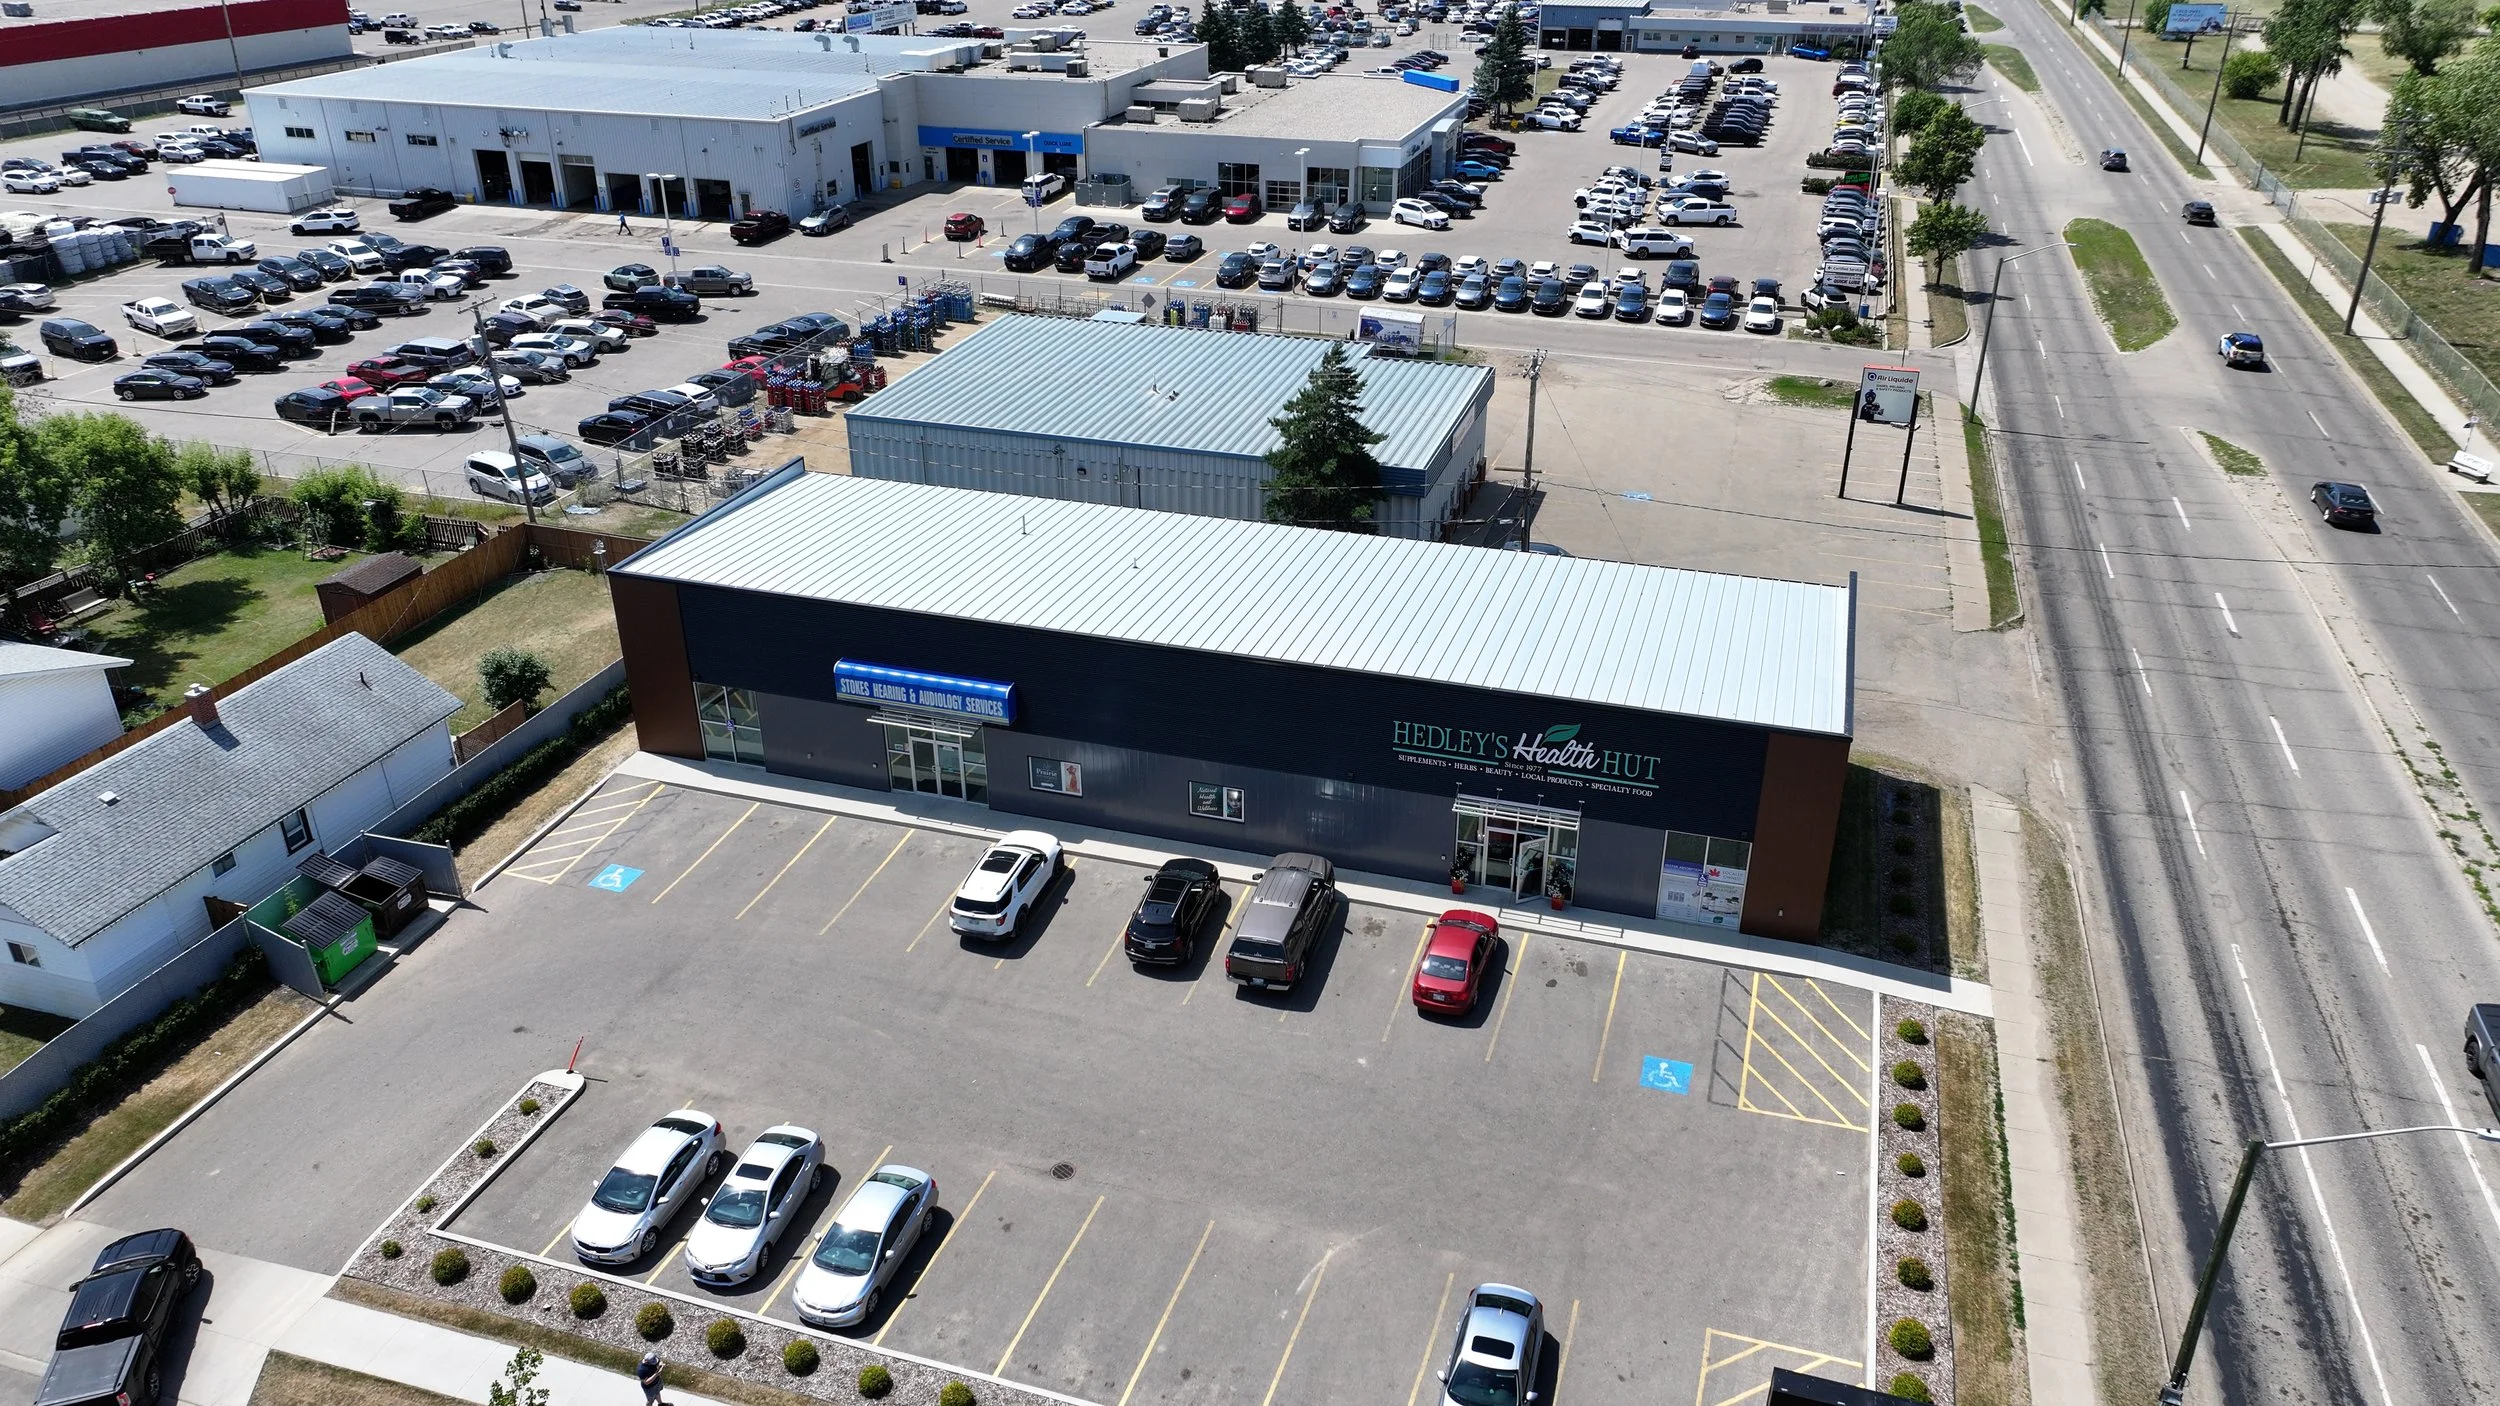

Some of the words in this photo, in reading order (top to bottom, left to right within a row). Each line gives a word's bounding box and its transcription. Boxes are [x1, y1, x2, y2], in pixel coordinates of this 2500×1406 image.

[874, 9, 895, 18] CERTIFIED
[953, 135, 983, 145] Certified
[985, 136, 1011, 146] Service
[1888, 376, 1914, 384] Liquide
[840, 678, 869, 697] STOKES
[873, 682, 907, 702] HEARING
[909, 689, 916, 703] &
[919, 690, 963, 711] AUDIOLOGY
[965, 697, 1003, 717] SERVICES
[1393, 720, 1508, 759] HEDLEY'S
[1512, 732, 1600, 769] Health
[1601, 750, 1661, 780] HUT
[1036, 767, 1057, 777] Prairie
[1504, 761, 1524, 771] Since
[1526, 764, 1542, 773] 1977
[1398, 754, 1447, 768] SUPPLEMENTS
[1454, 762, 1478, 772] HERBS
[1485, 767, 1513, 777] BEAUTY
[1521, 772, 1546, 782] LOCAL
[1547, 776, 1583, 787] PRODUCTS
[1591, 782, 1631, 794] SPECIALTY
[1632, 788, 1653, 797] FOOD
[1197, 786, 1218, 794] Natural
